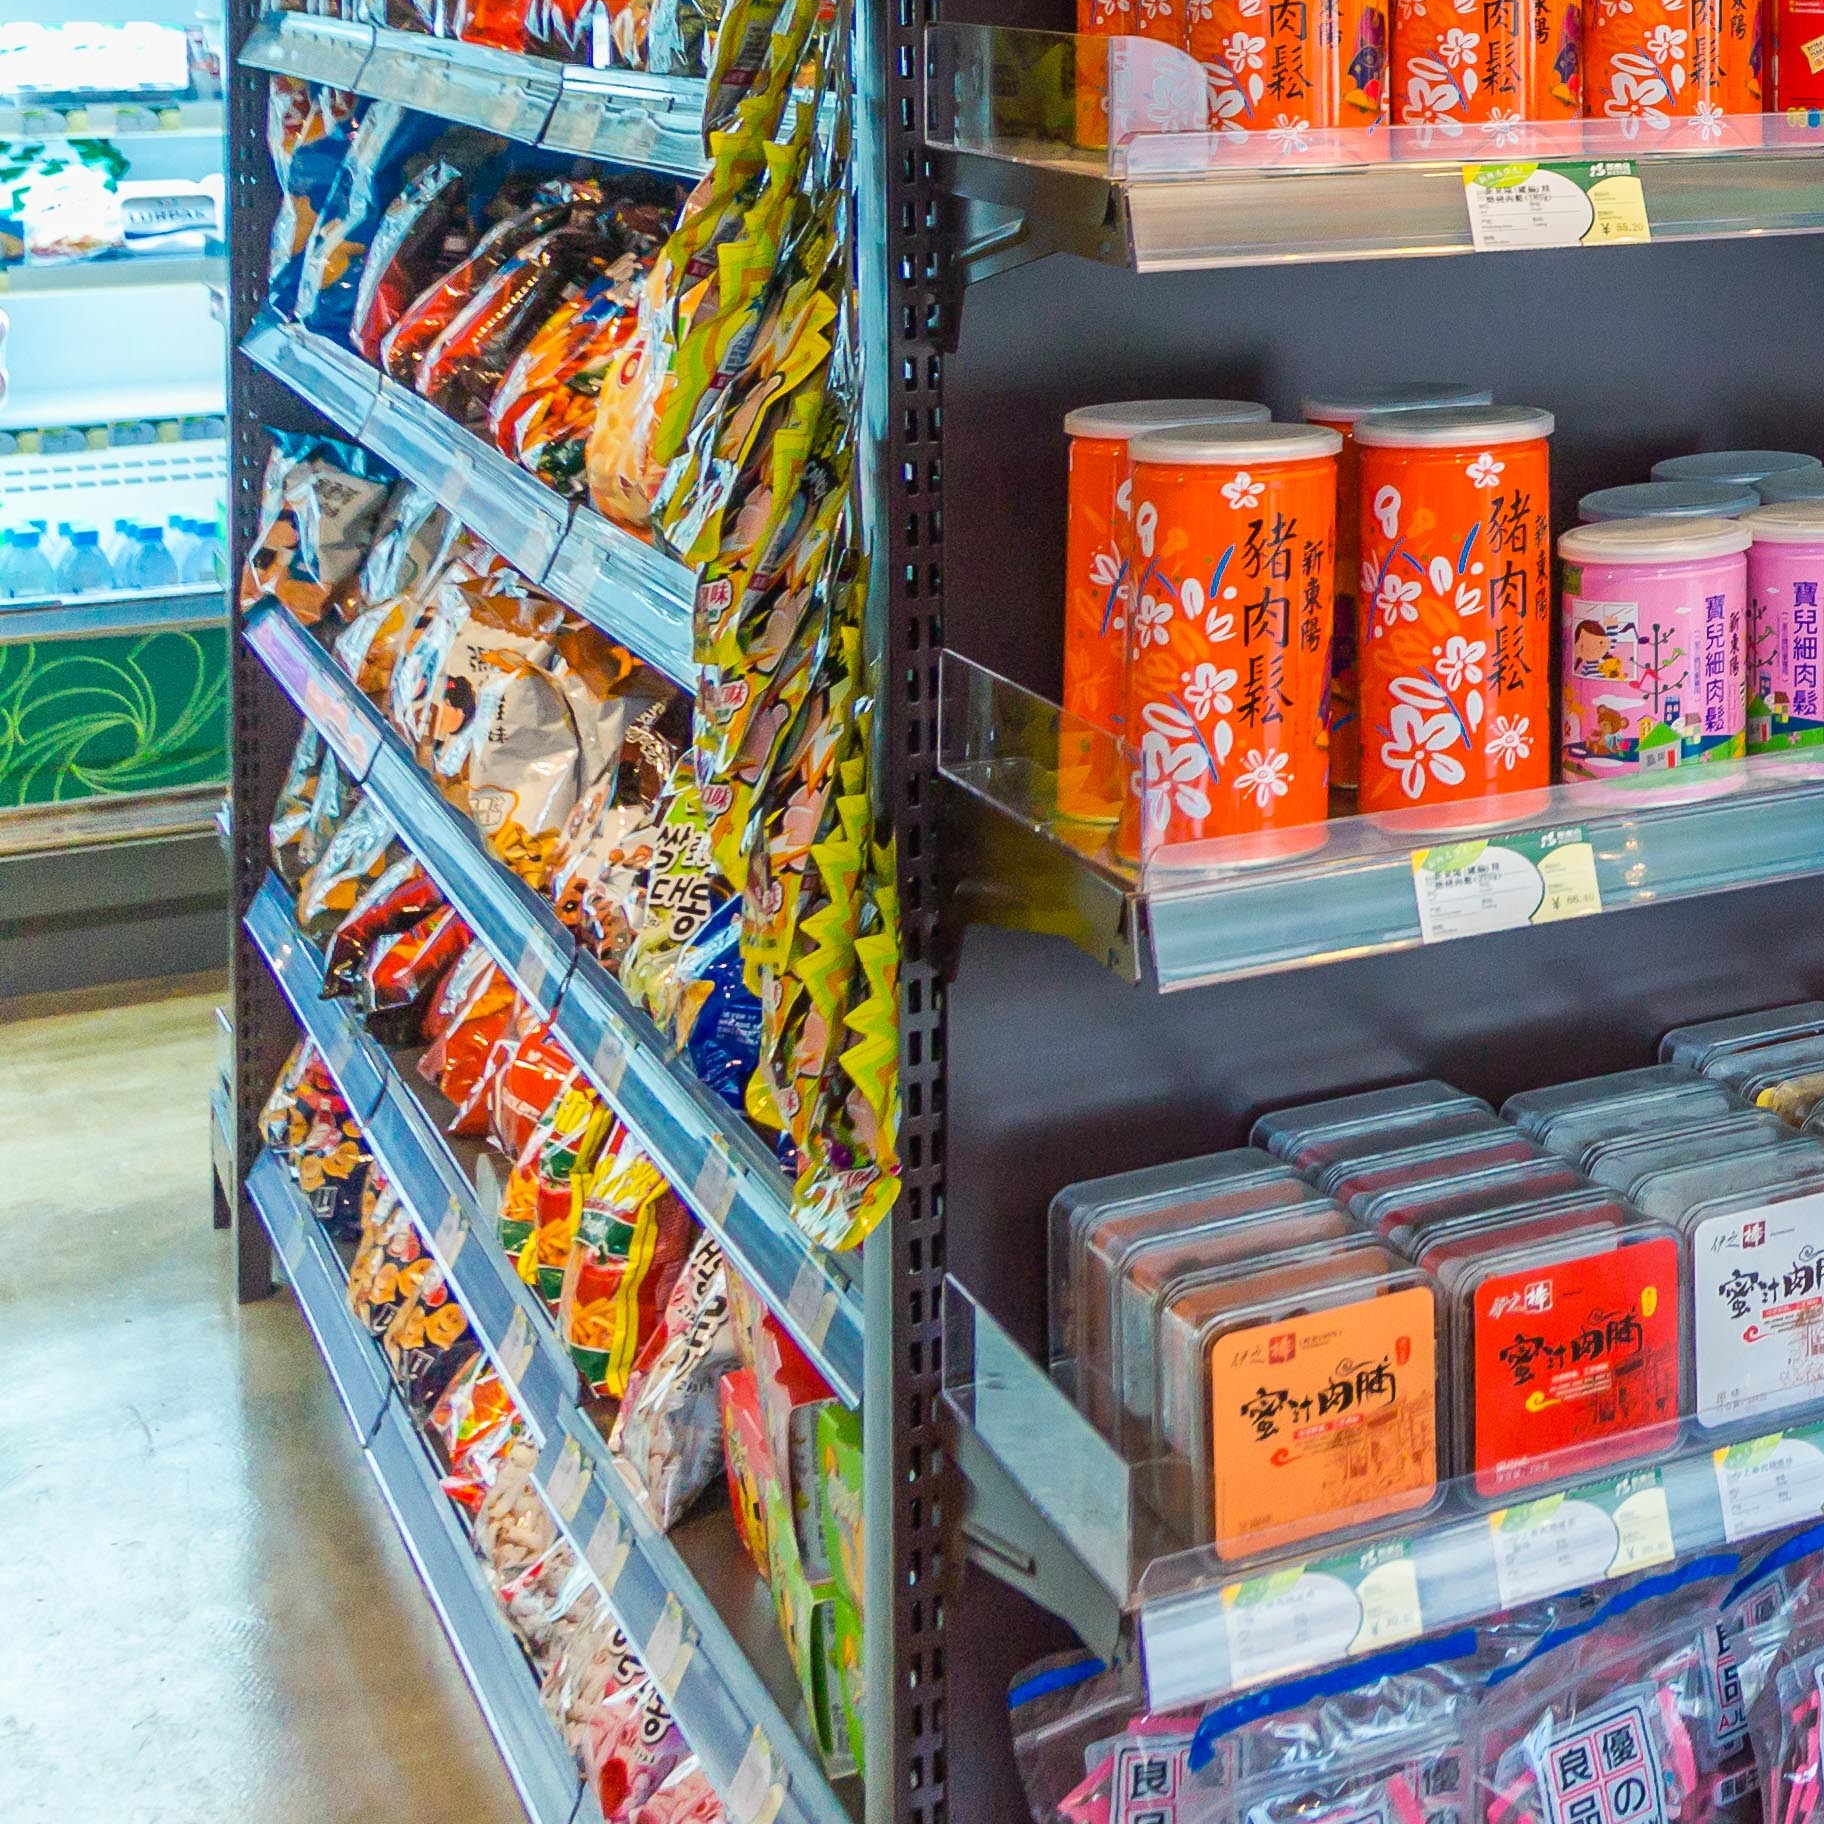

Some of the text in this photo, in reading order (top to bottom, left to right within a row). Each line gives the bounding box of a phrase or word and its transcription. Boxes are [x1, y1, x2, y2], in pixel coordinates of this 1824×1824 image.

[1237, 512, 1298, 729] 豬肉鬆
[1300, 540, 1322, 654] 新東陽
[1486, 489, 1533, 697] 豬肉鬆
